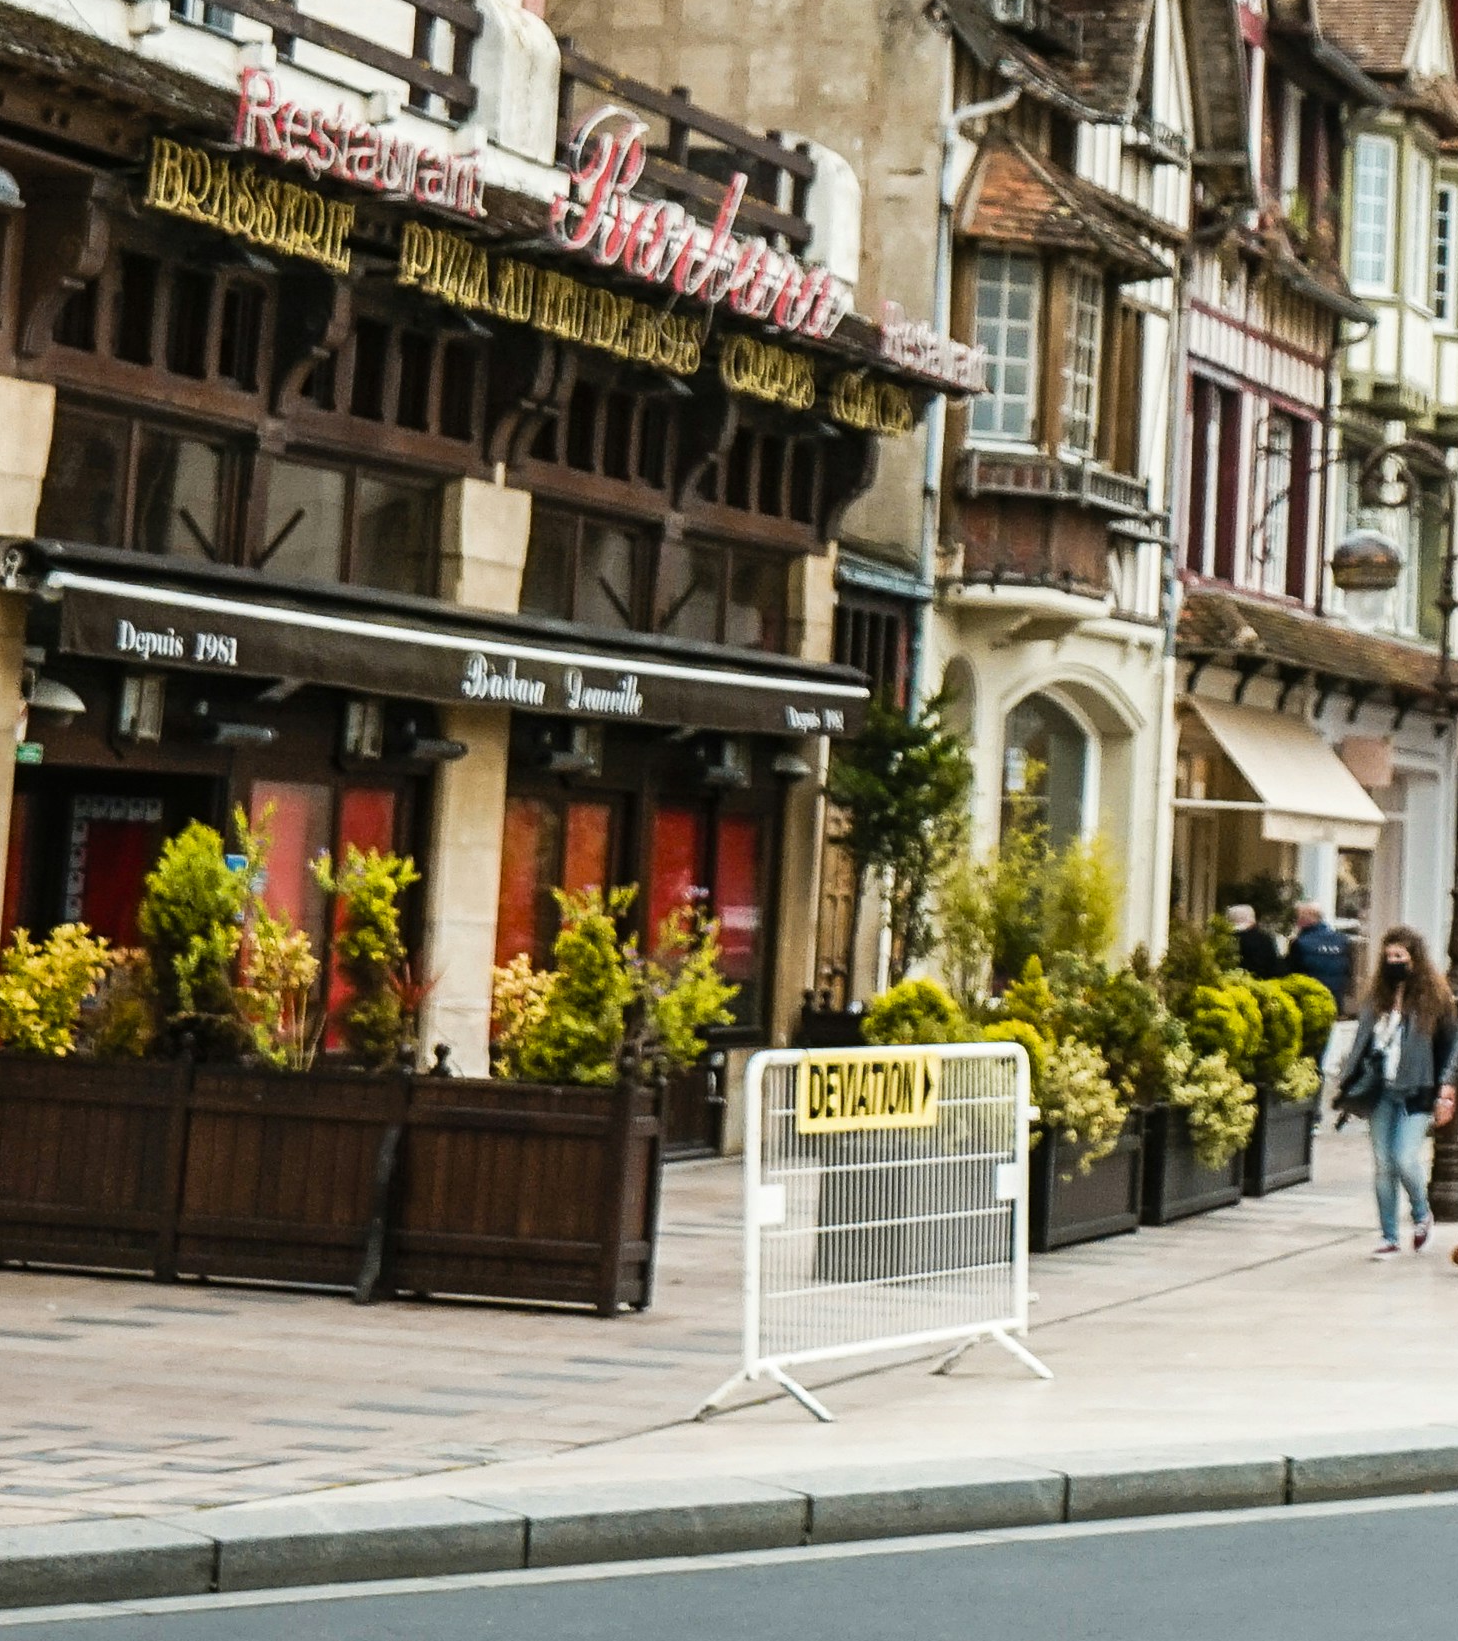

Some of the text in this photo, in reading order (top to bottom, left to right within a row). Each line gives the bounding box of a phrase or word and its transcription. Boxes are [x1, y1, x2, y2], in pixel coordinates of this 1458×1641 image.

[143, 135, 355, 274] BRASSERIE
[116, 618, 185, 661] Depuis
[193, 632, 238, 667] 1981
[808, 1060, 917, 1119] DEVIATION
